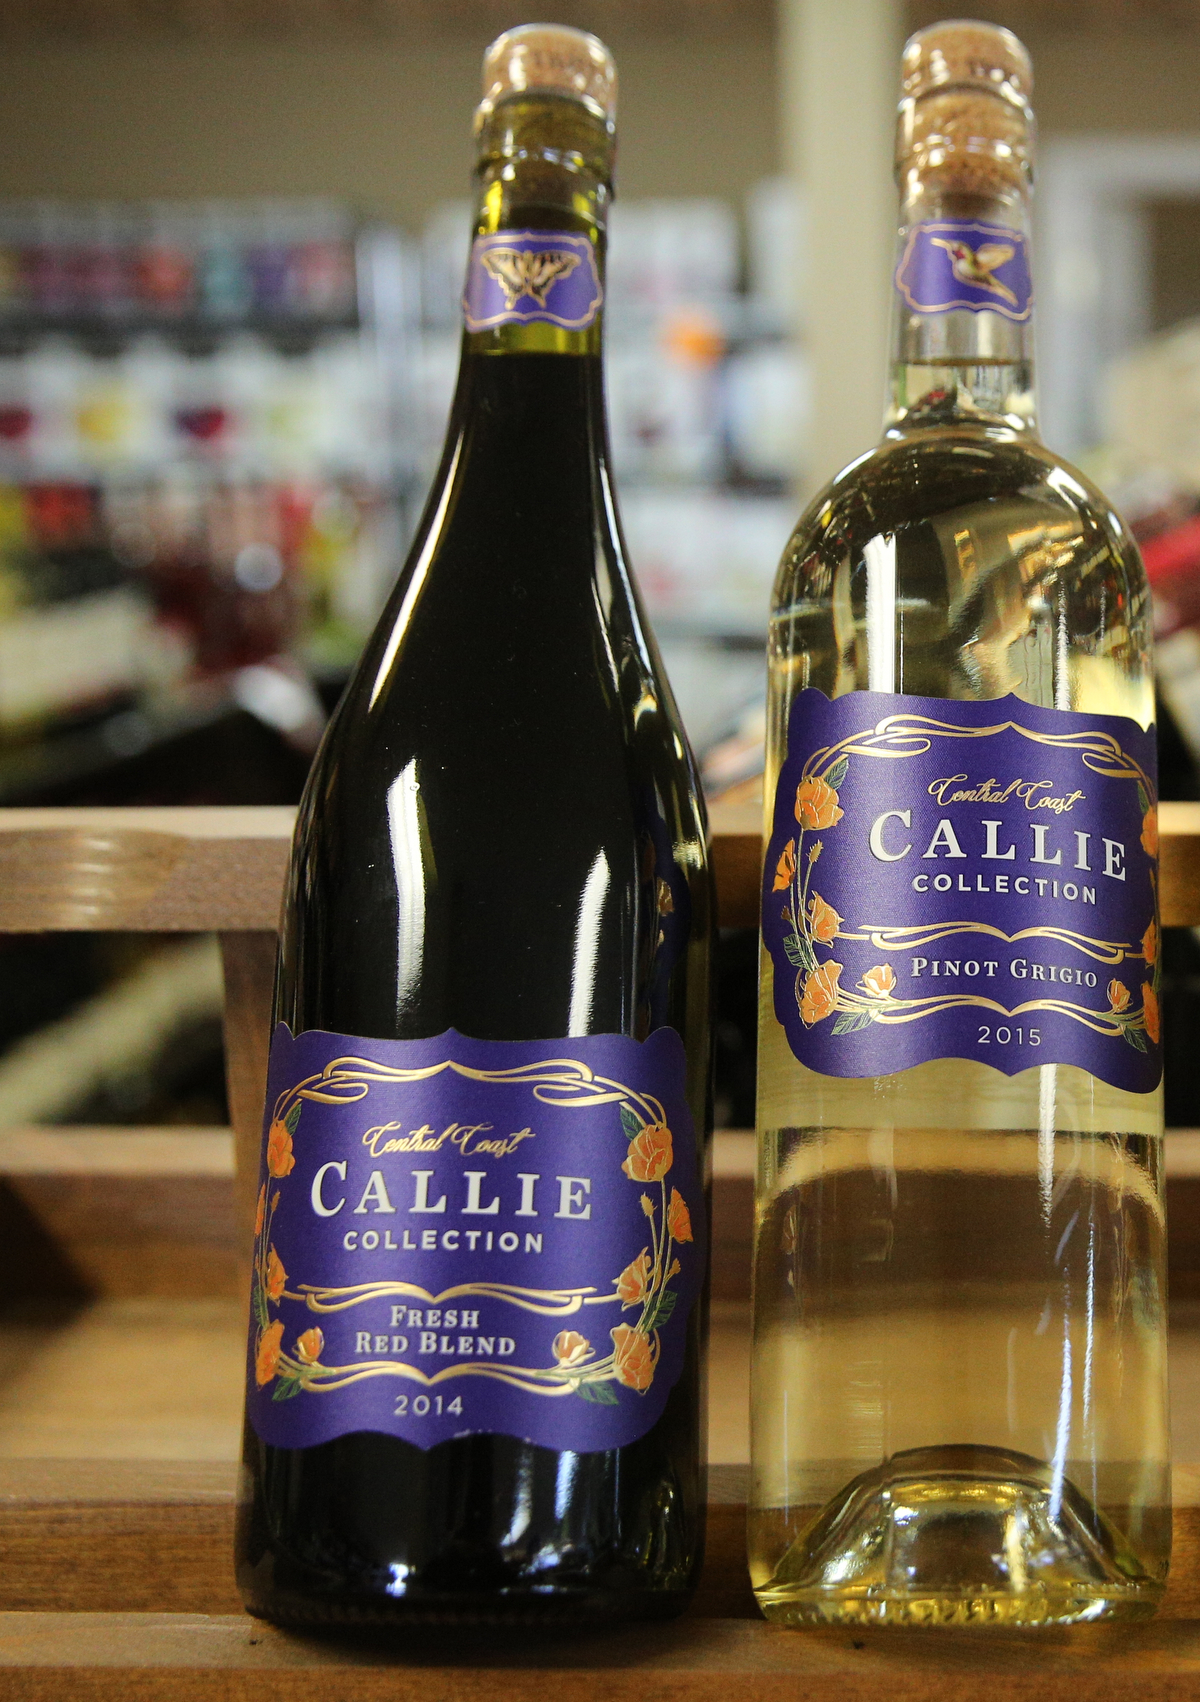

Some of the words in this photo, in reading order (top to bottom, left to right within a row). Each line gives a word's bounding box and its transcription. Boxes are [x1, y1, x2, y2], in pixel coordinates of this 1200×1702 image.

[927, 773, 1021, 807] Central
[1015, 778, 1086, 815] Coast
[868, 809, 1127, 882] CALLIE
[911, 873, 1097, 906] COLLECTION
[910, 956, 999, 978] PINOT
[1009, 958, 1098, 988] GRIGIO
[977, 1025, 1042, 1046] 2015
[362, 1121, 457, 1158] Central
[450, 1121, 536, 1159] Coast
[310, 1159, 593, 1221] CALLIE
[342, 1229, 544, 1254] COLLECTION
[389, 1304, 481, 1330] FRESH
[354, 1330, 410, 1356] RED
[418, 1331, 517, 1357] BLEND
[393, 1394, 464, 1418] 2014
